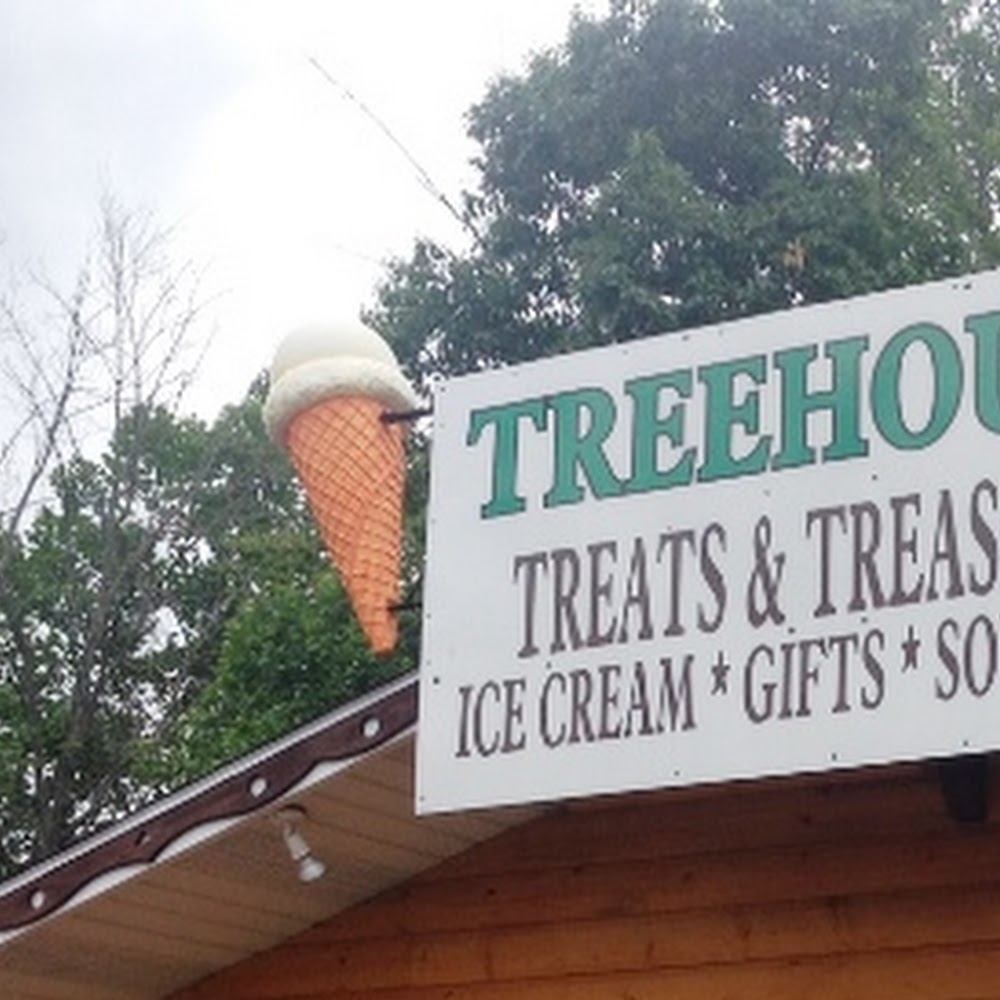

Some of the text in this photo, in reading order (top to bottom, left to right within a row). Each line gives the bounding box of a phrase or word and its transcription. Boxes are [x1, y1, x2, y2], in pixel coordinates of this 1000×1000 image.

[513, 522, 728, 659] TREATS
[746, 515, 786, 629] &
[455, 678, 528, 759] ICE
[539, 654, 697, 749] CREAM
[743, 628, 886, 725] GIFTS
